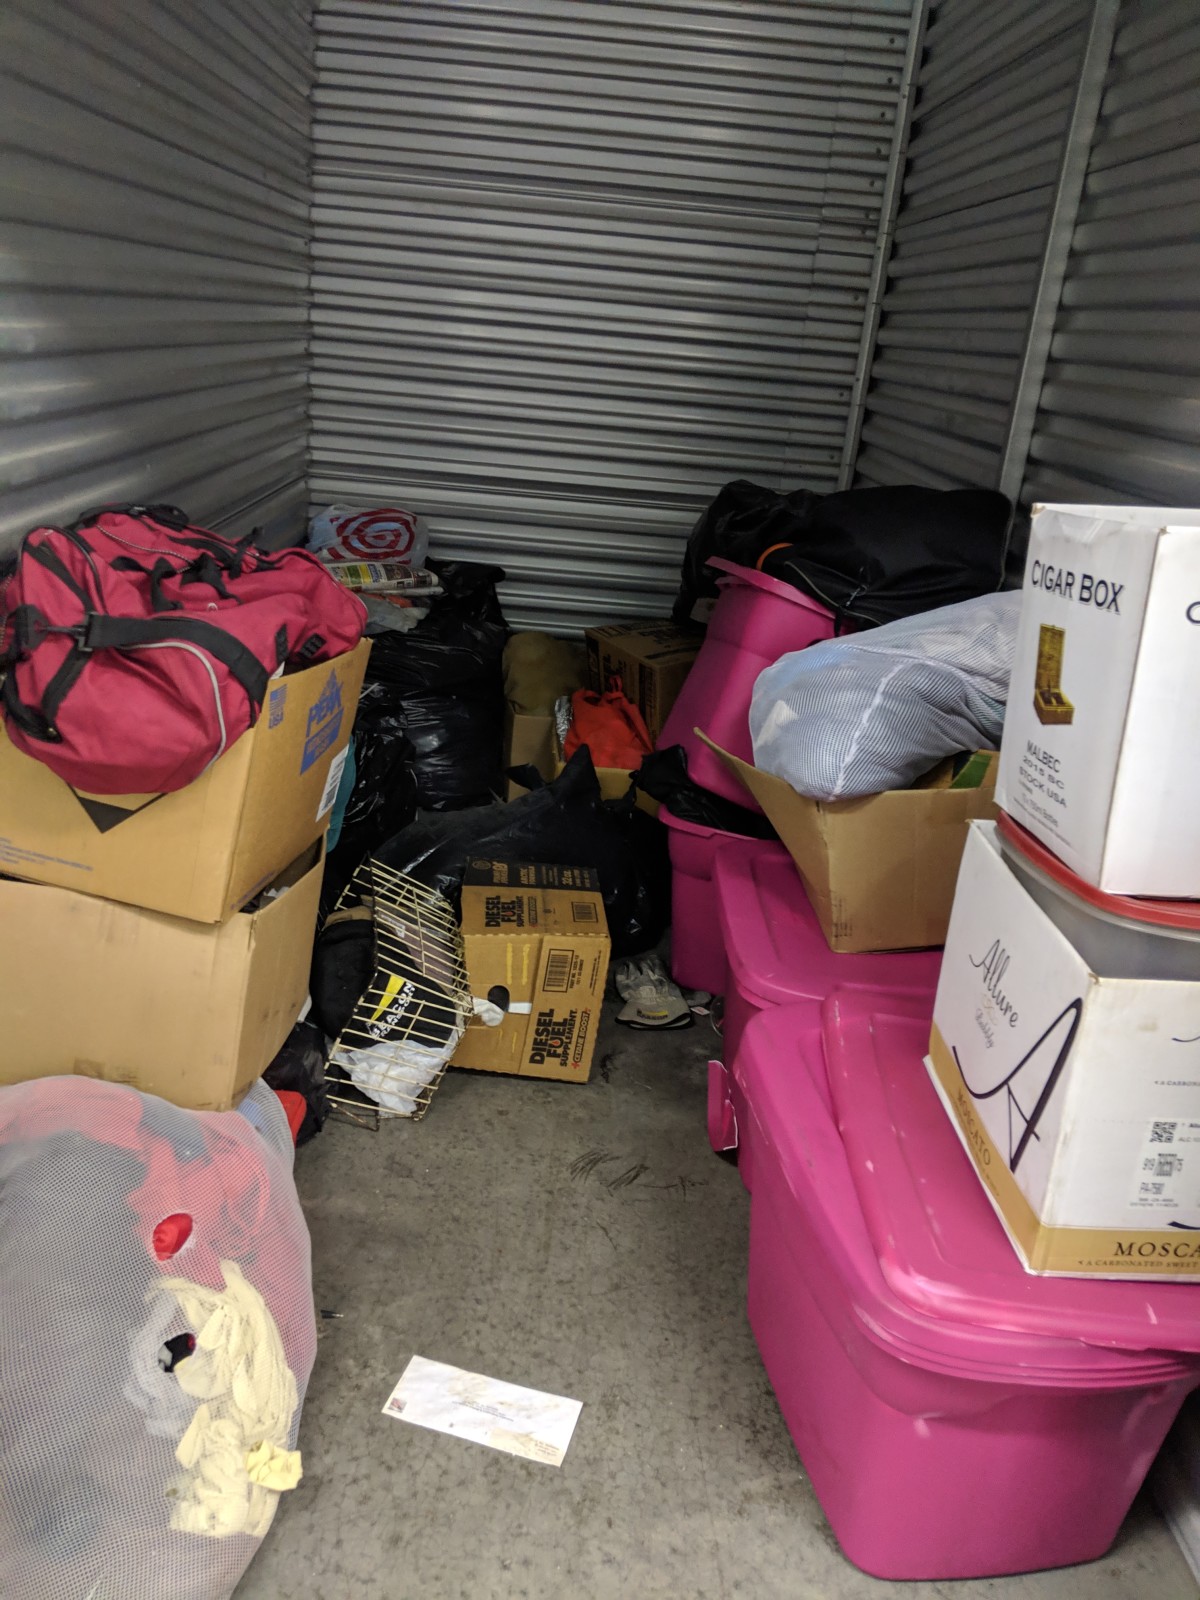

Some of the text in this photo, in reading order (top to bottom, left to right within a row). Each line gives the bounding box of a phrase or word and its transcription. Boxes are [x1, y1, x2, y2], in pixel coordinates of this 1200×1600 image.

[1031, 560, 1124, 614] CIGAR BOX
[1026, 740, 1061, 773] MALBEC
[1019, 766, 1045, 793] STOCK
[1046, 787, 1067, 808] USA
[485, 895, 501, 928] DIESEL
[501, 900, 517, 922] FUEL
[516, 895, 525, 928] SUPPLEMENT
[969, 939, 1020, 1028] Allure
[529, 1008, 555, 1065] DIESEL
[546, 1018, 569, 1058] FUEL
[560, 1009, 577, 1067] SUPPLEMENT
